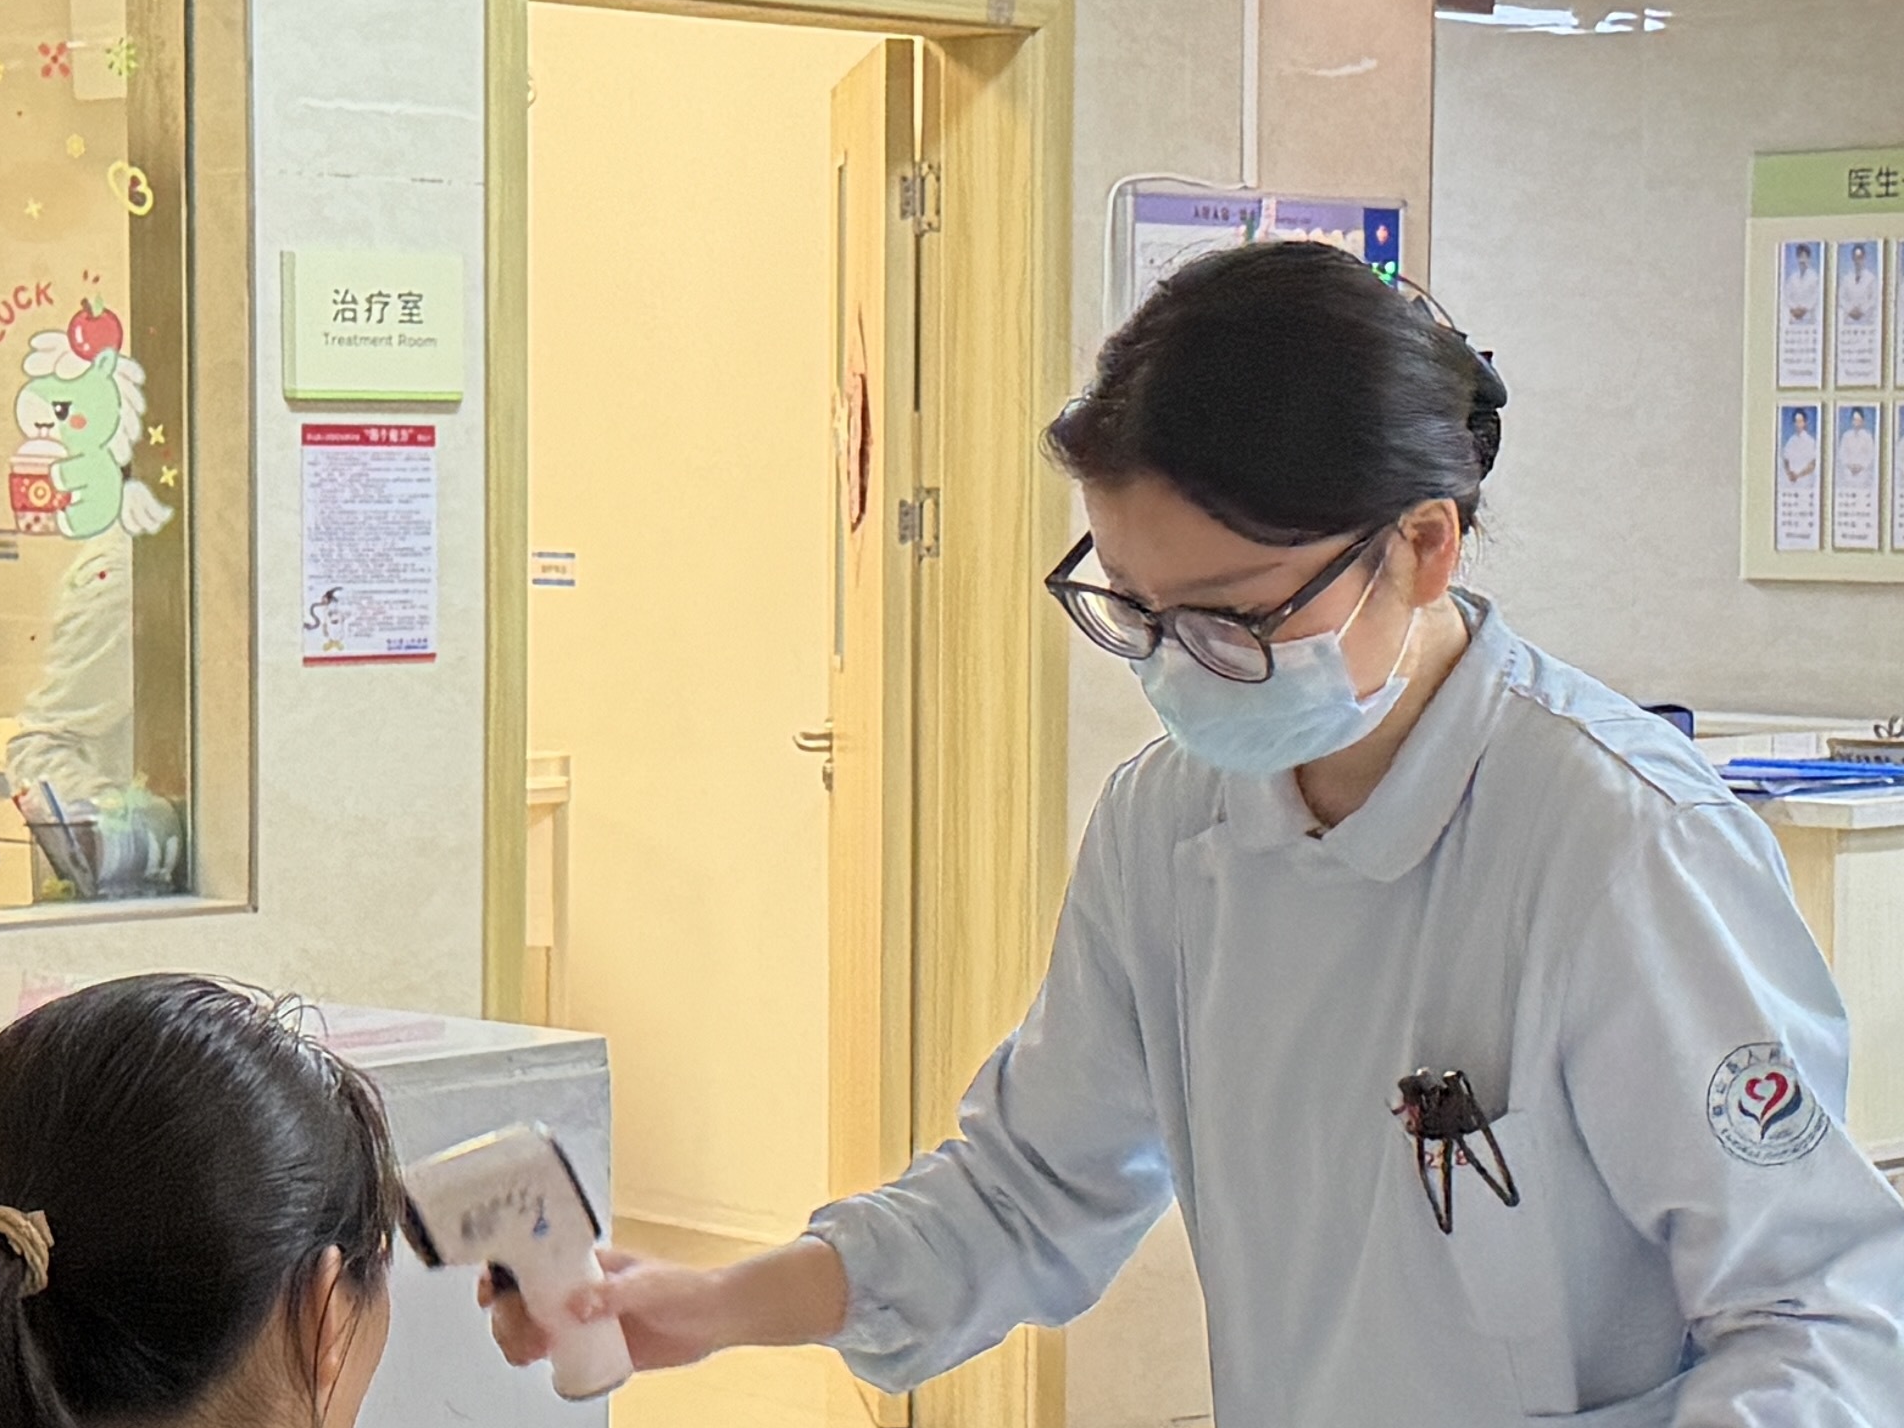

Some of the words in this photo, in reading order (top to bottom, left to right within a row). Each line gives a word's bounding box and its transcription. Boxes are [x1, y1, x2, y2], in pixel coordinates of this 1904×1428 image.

[331, 288, 425, 324] 治疗室
[323, 332, 393, 348] Treatment
[398, 333, 438, 348] Room
